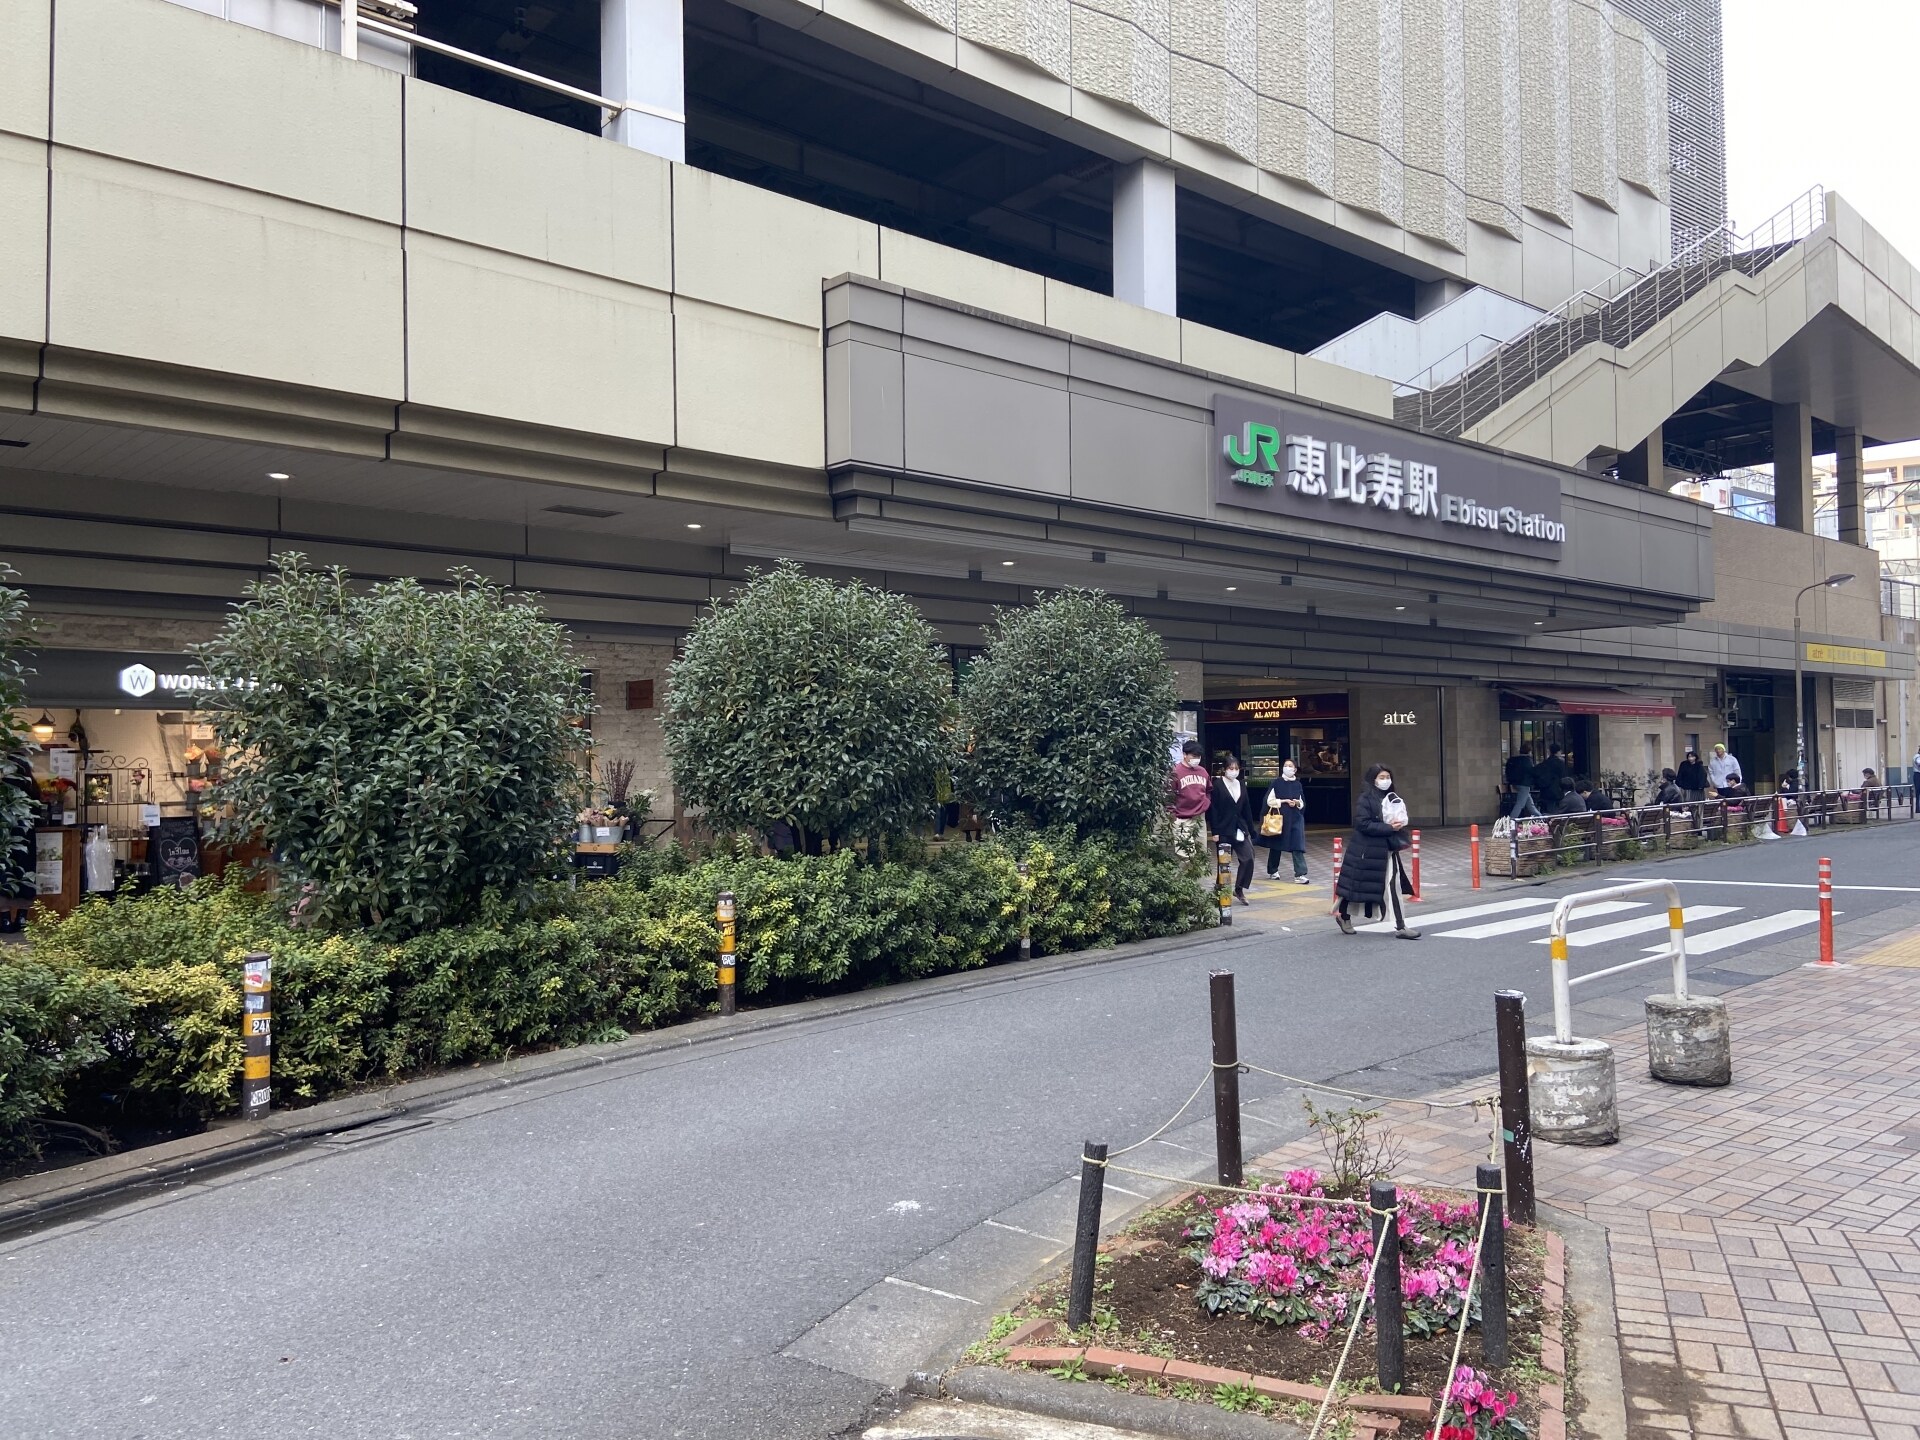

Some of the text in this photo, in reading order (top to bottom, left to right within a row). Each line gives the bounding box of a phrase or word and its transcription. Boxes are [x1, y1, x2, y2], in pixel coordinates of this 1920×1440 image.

[1223, 421, 1280, 472] JR
[1286, 435, 1439, 518] 恵比寿駅
[1441, 493, 1566, 542] Ebisu Station
[1237, 697, 1298, 711] ANTICO CAFFÈ
[1254, 711, 1280, 719] AL AVIS
[1383, 710, 1416, 724] atré
